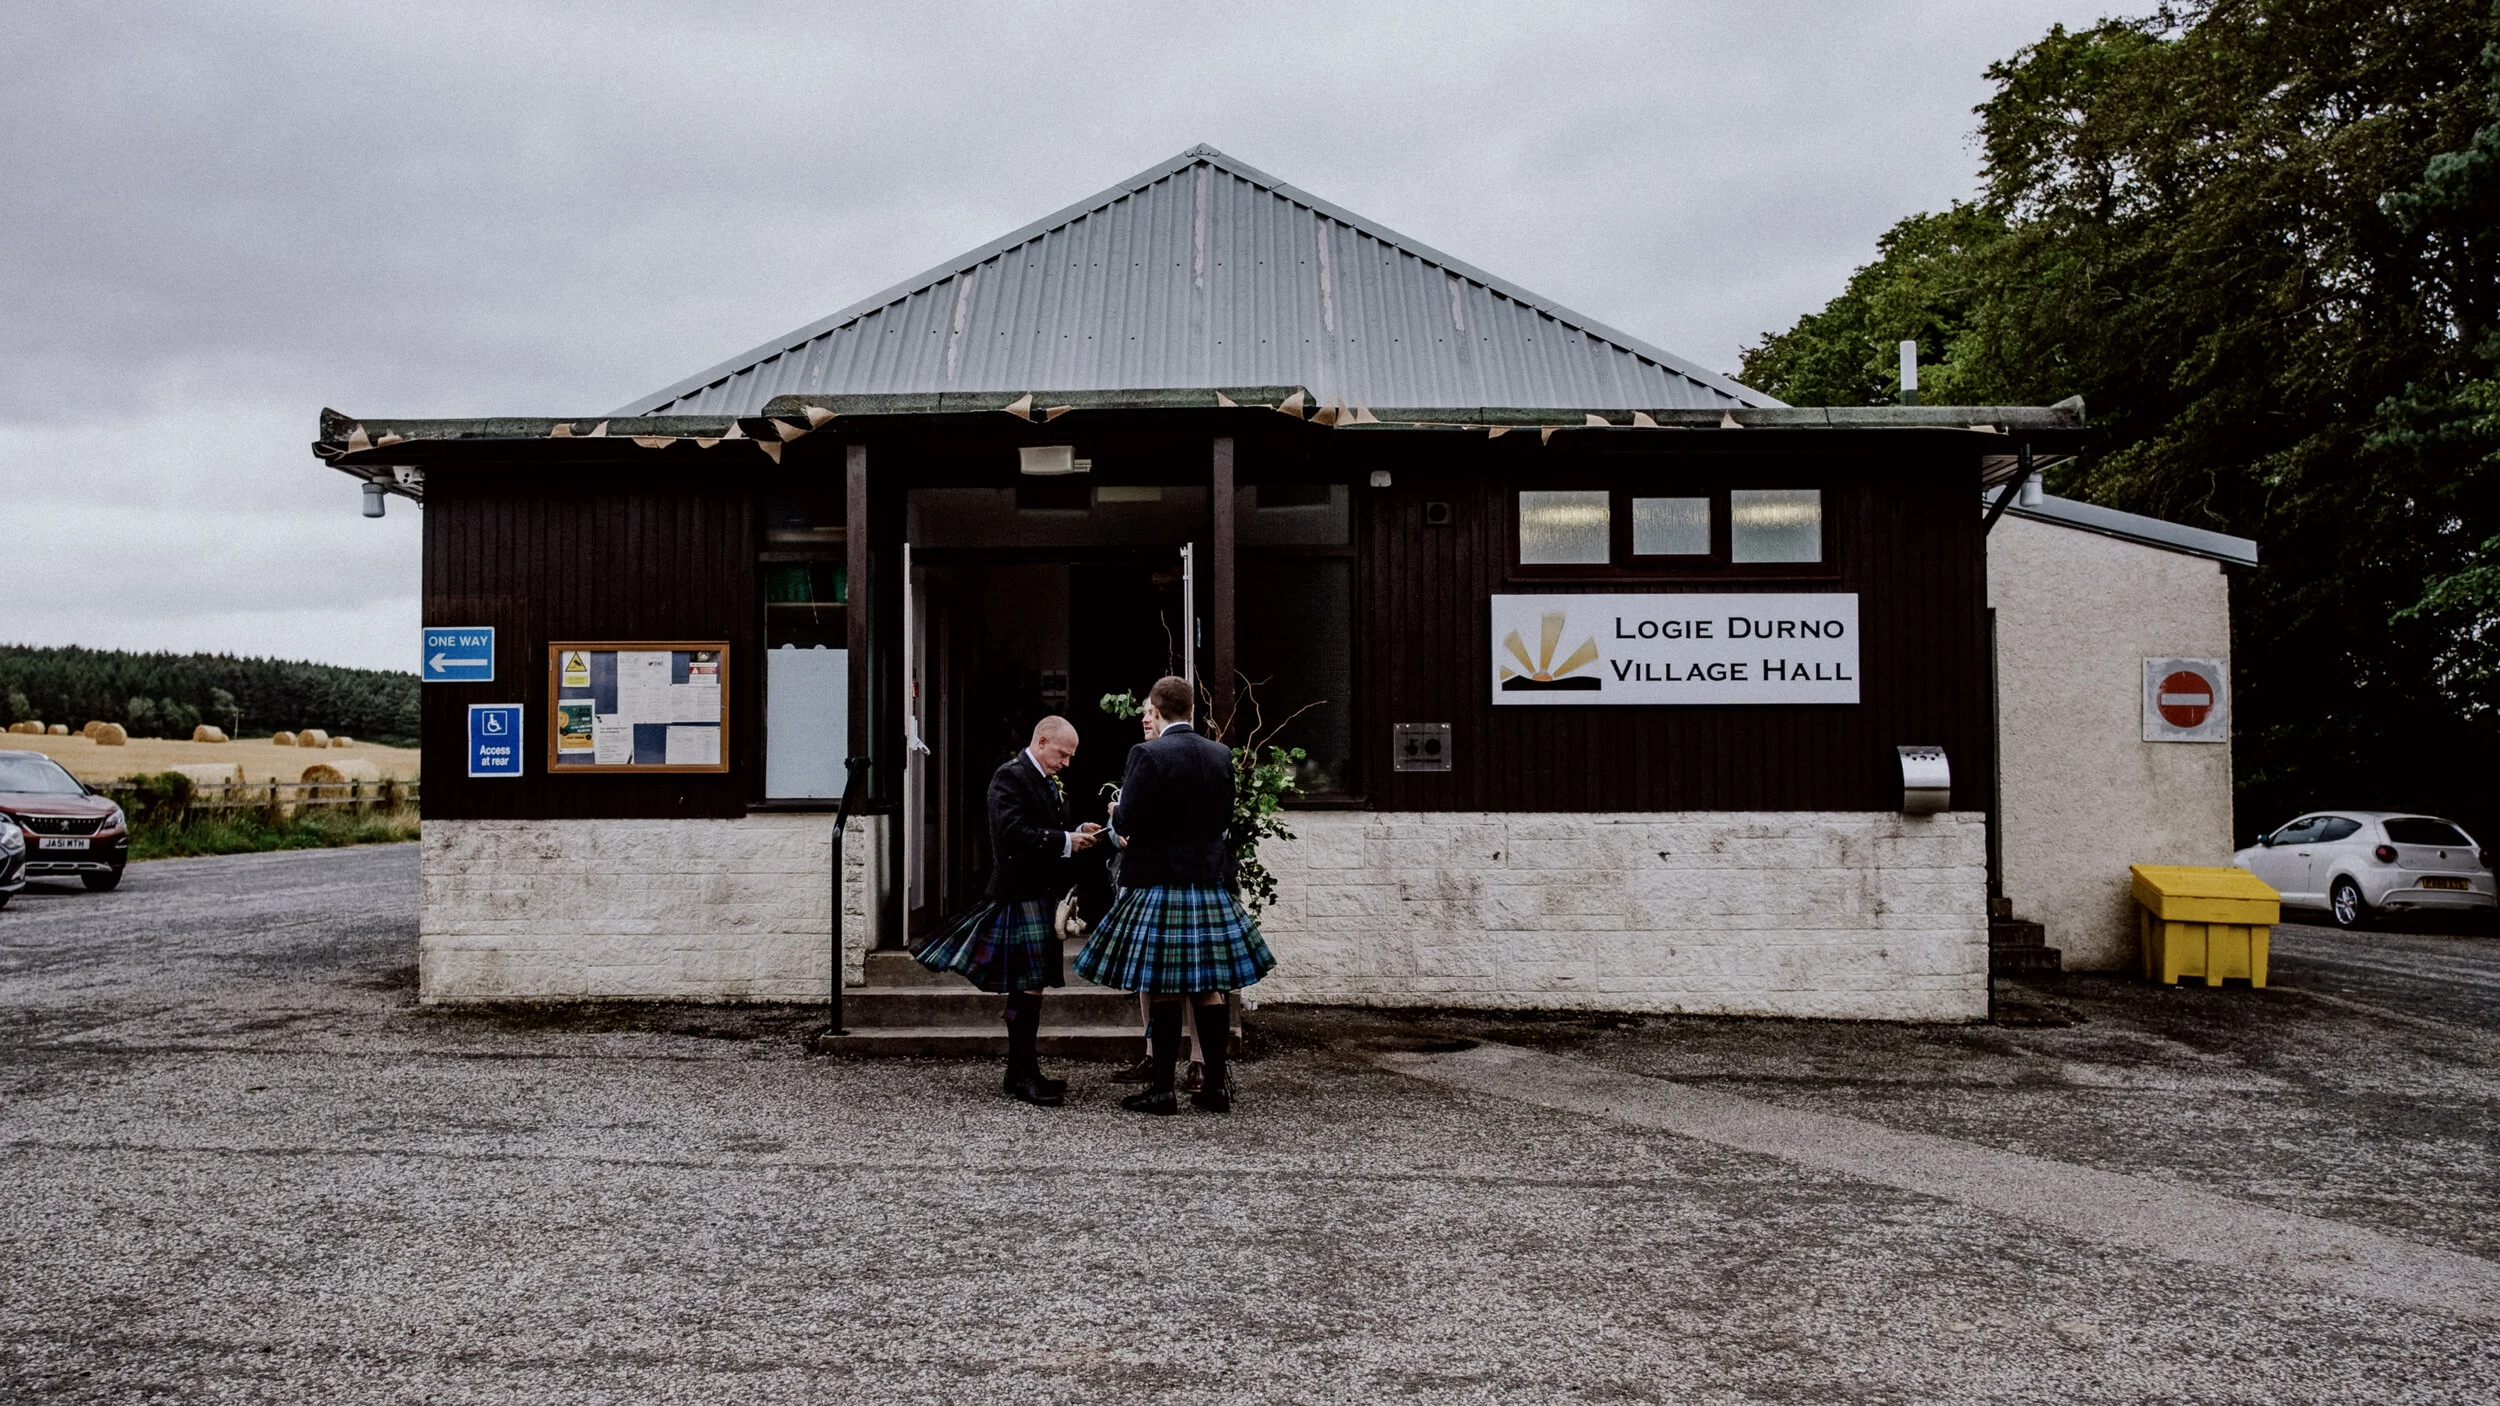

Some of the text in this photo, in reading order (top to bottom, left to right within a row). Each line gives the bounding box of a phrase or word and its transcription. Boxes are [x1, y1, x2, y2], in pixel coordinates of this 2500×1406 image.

[1615, 616, 1845, 640] LOGIE DURNO
[428, 635, 488, 647] ONE WAY
[1610, 659, 1853, 682] VILLAGE HALL
[480, 744, 511, 755] Access
[481, 756, 509, 766] at rear
